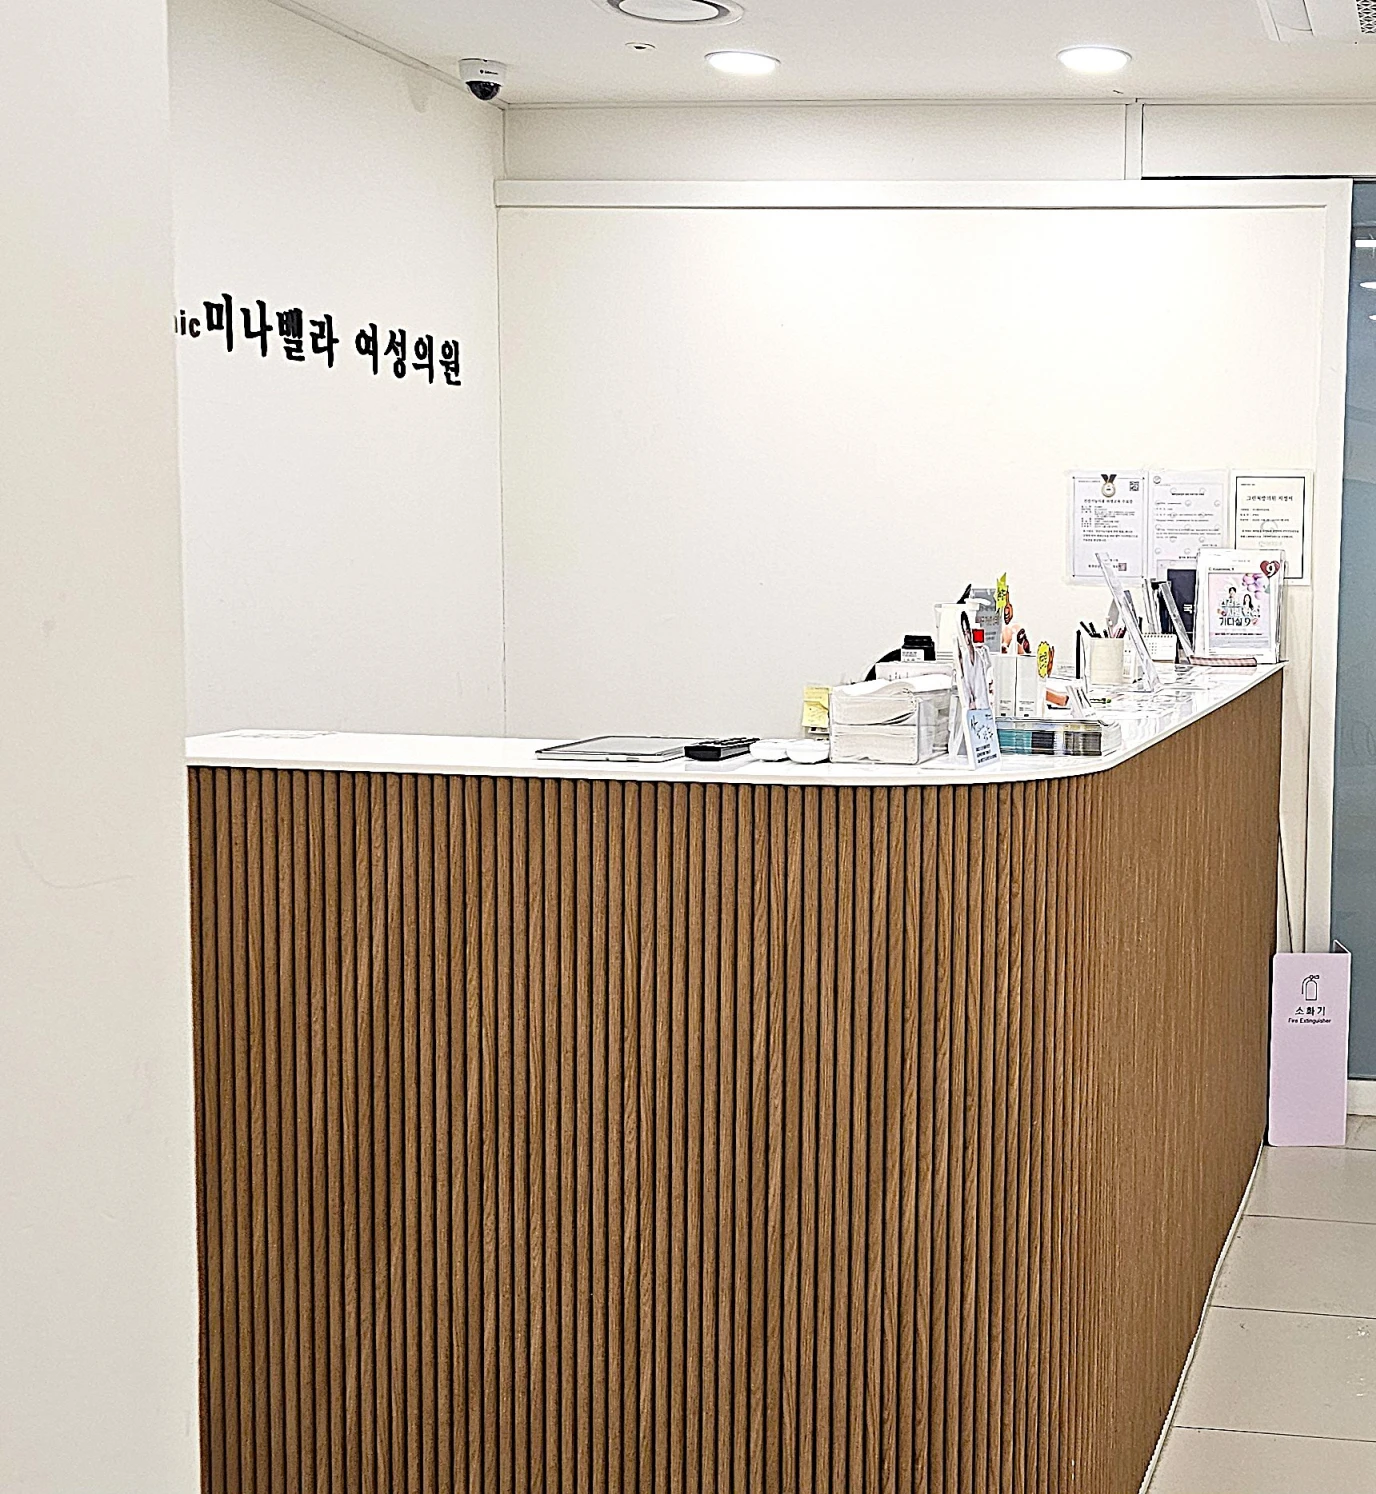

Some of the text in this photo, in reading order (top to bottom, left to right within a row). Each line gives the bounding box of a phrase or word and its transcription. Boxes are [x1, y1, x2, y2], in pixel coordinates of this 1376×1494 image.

[173, 293, 461, 386] ic 미나벨라 여성의원
[1295, 1006, 1326, 1016] 소화기
